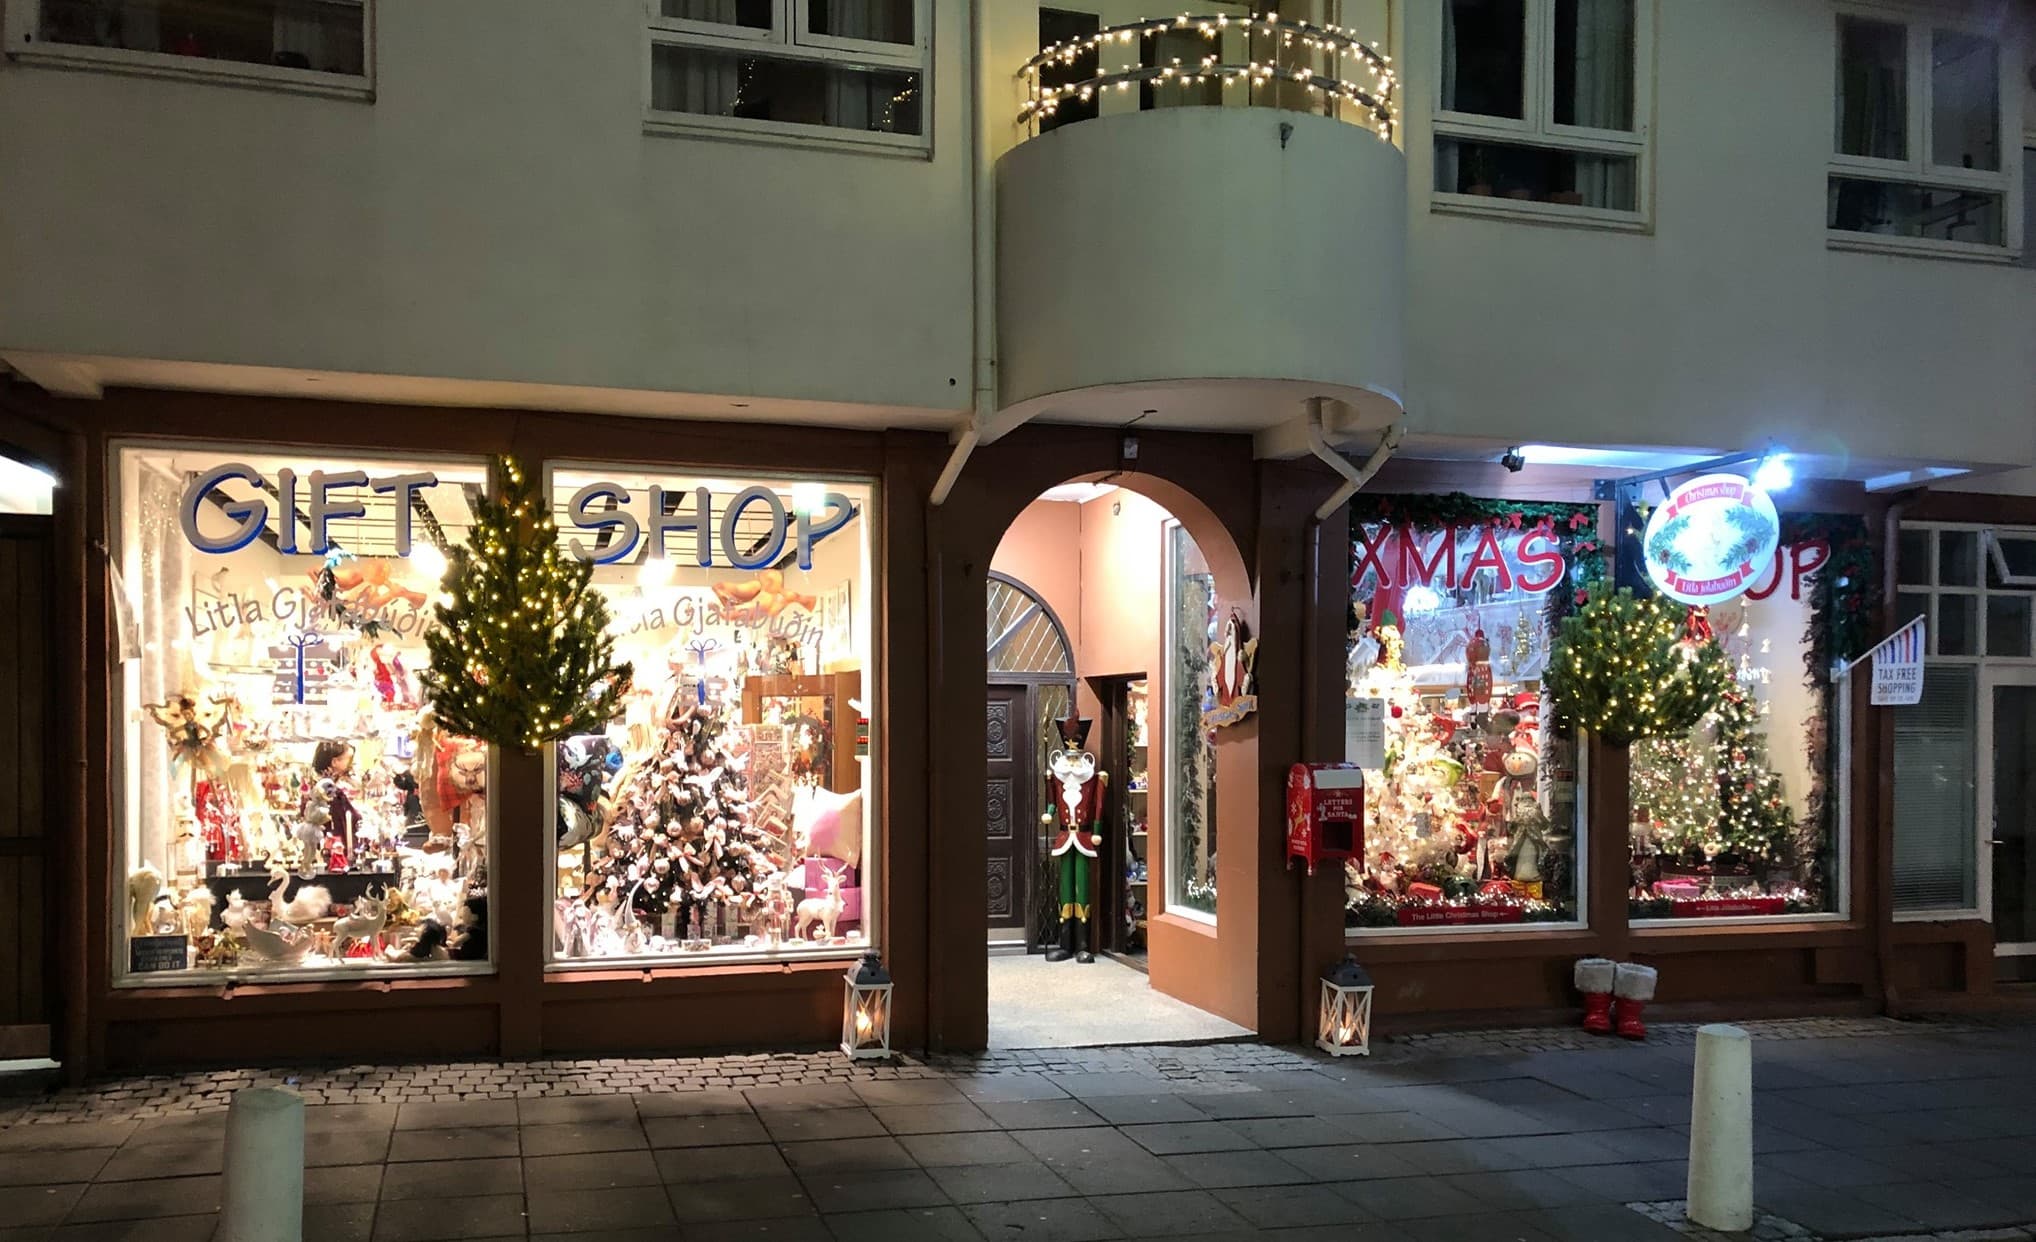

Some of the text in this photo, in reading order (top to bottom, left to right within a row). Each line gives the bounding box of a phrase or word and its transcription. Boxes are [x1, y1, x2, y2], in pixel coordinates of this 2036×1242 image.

[179, 462, 854, 570] GIFT SHOP
[1350, 520, 1567, 594] XMAS
[185, 593, 264, 637] Litla
[1877, 682, 1917, 695] SHOPPING
[1878, 667, 1917, 681] TAX FREE
